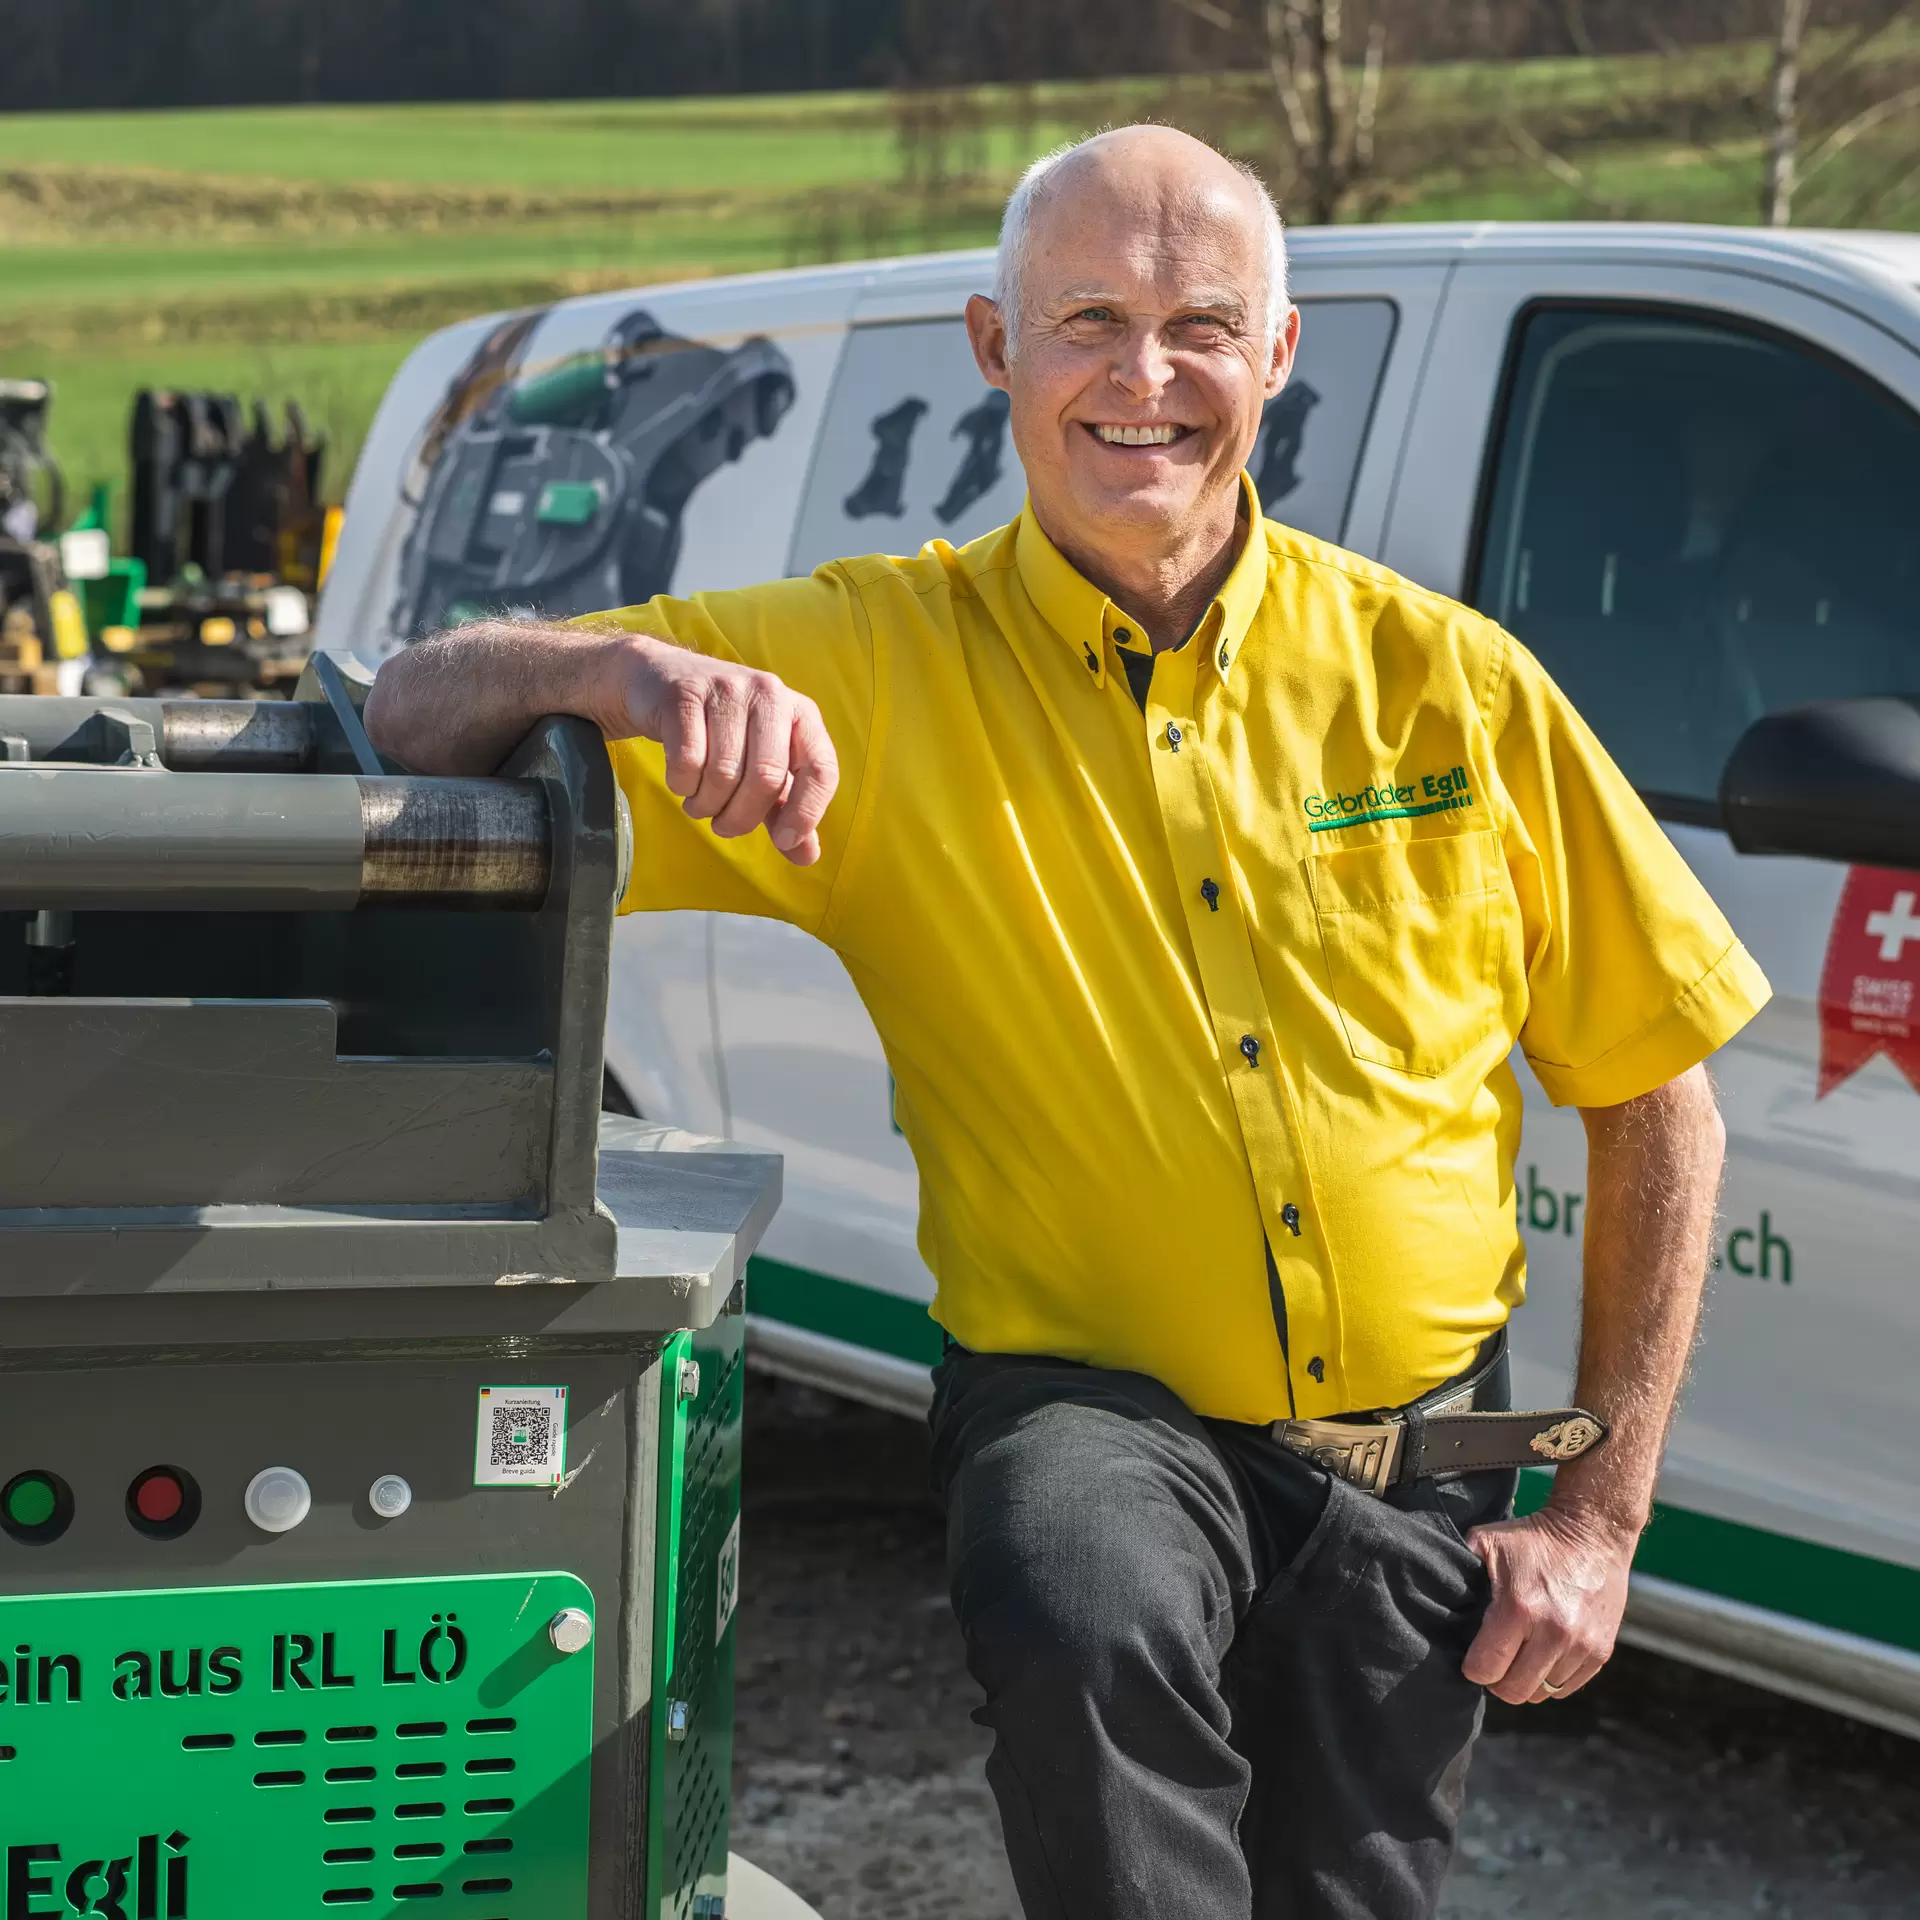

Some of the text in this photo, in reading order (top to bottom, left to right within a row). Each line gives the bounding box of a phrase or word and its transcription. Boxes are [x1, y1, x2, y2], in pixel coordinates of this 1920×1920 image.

[1304, 766, 1469, 817] Gebrüder Egli
[0, 1612, 468, 1705] in aus RL LÖ
